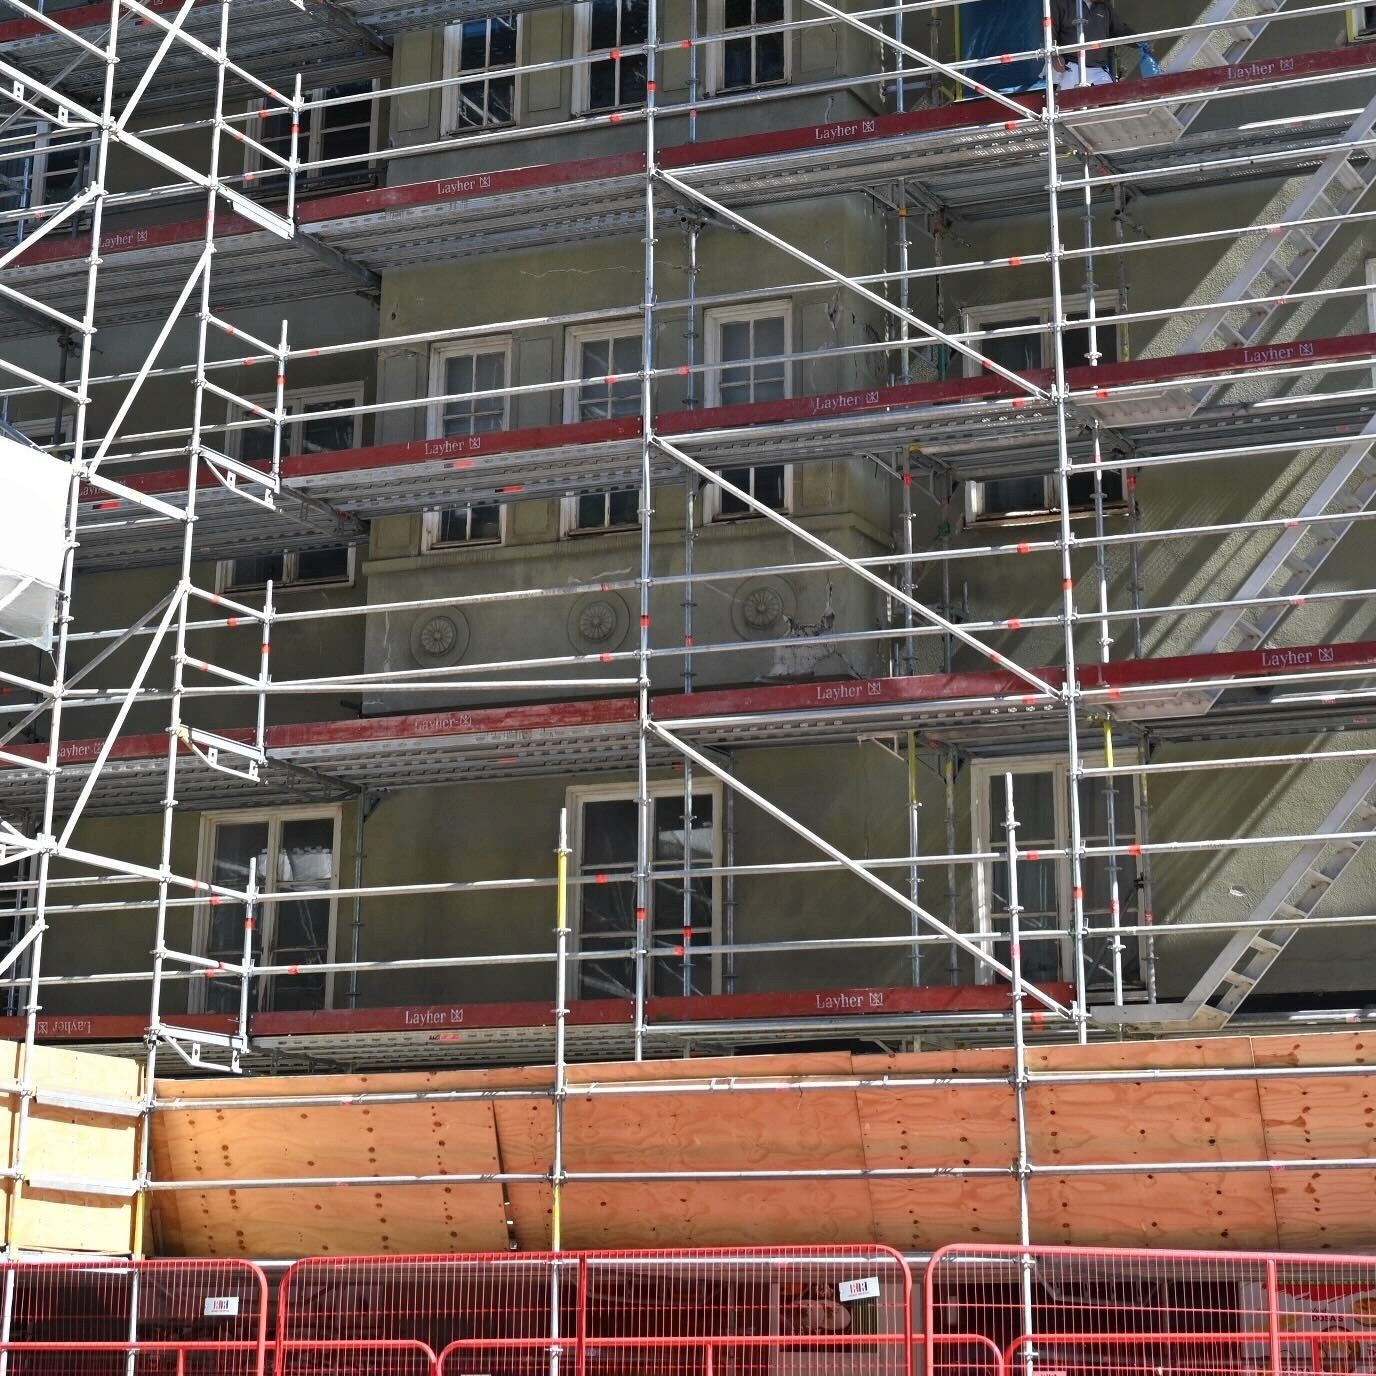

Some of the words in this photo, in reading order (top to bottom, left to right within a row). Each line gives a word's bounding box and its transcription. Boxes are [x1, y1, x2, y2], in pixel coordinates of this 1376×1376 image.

[1227, 63, 1275, 79] Layher
[815, 124, 858, 140] Layher
[437, 180, 476, 195] Layher
[1244, 347, 1294, 363] Layher
[816, 395, 859, 410] Layher
[425, 440, 465, 455] Layher
[1261, 651, 1313, 667] Layher
[816, 685, 863, 700] Layher
[58, 744, 91, 758] ayher
[816, 994, 864, 1009] Layher
[405, 1010, 447, 1025] Layher
